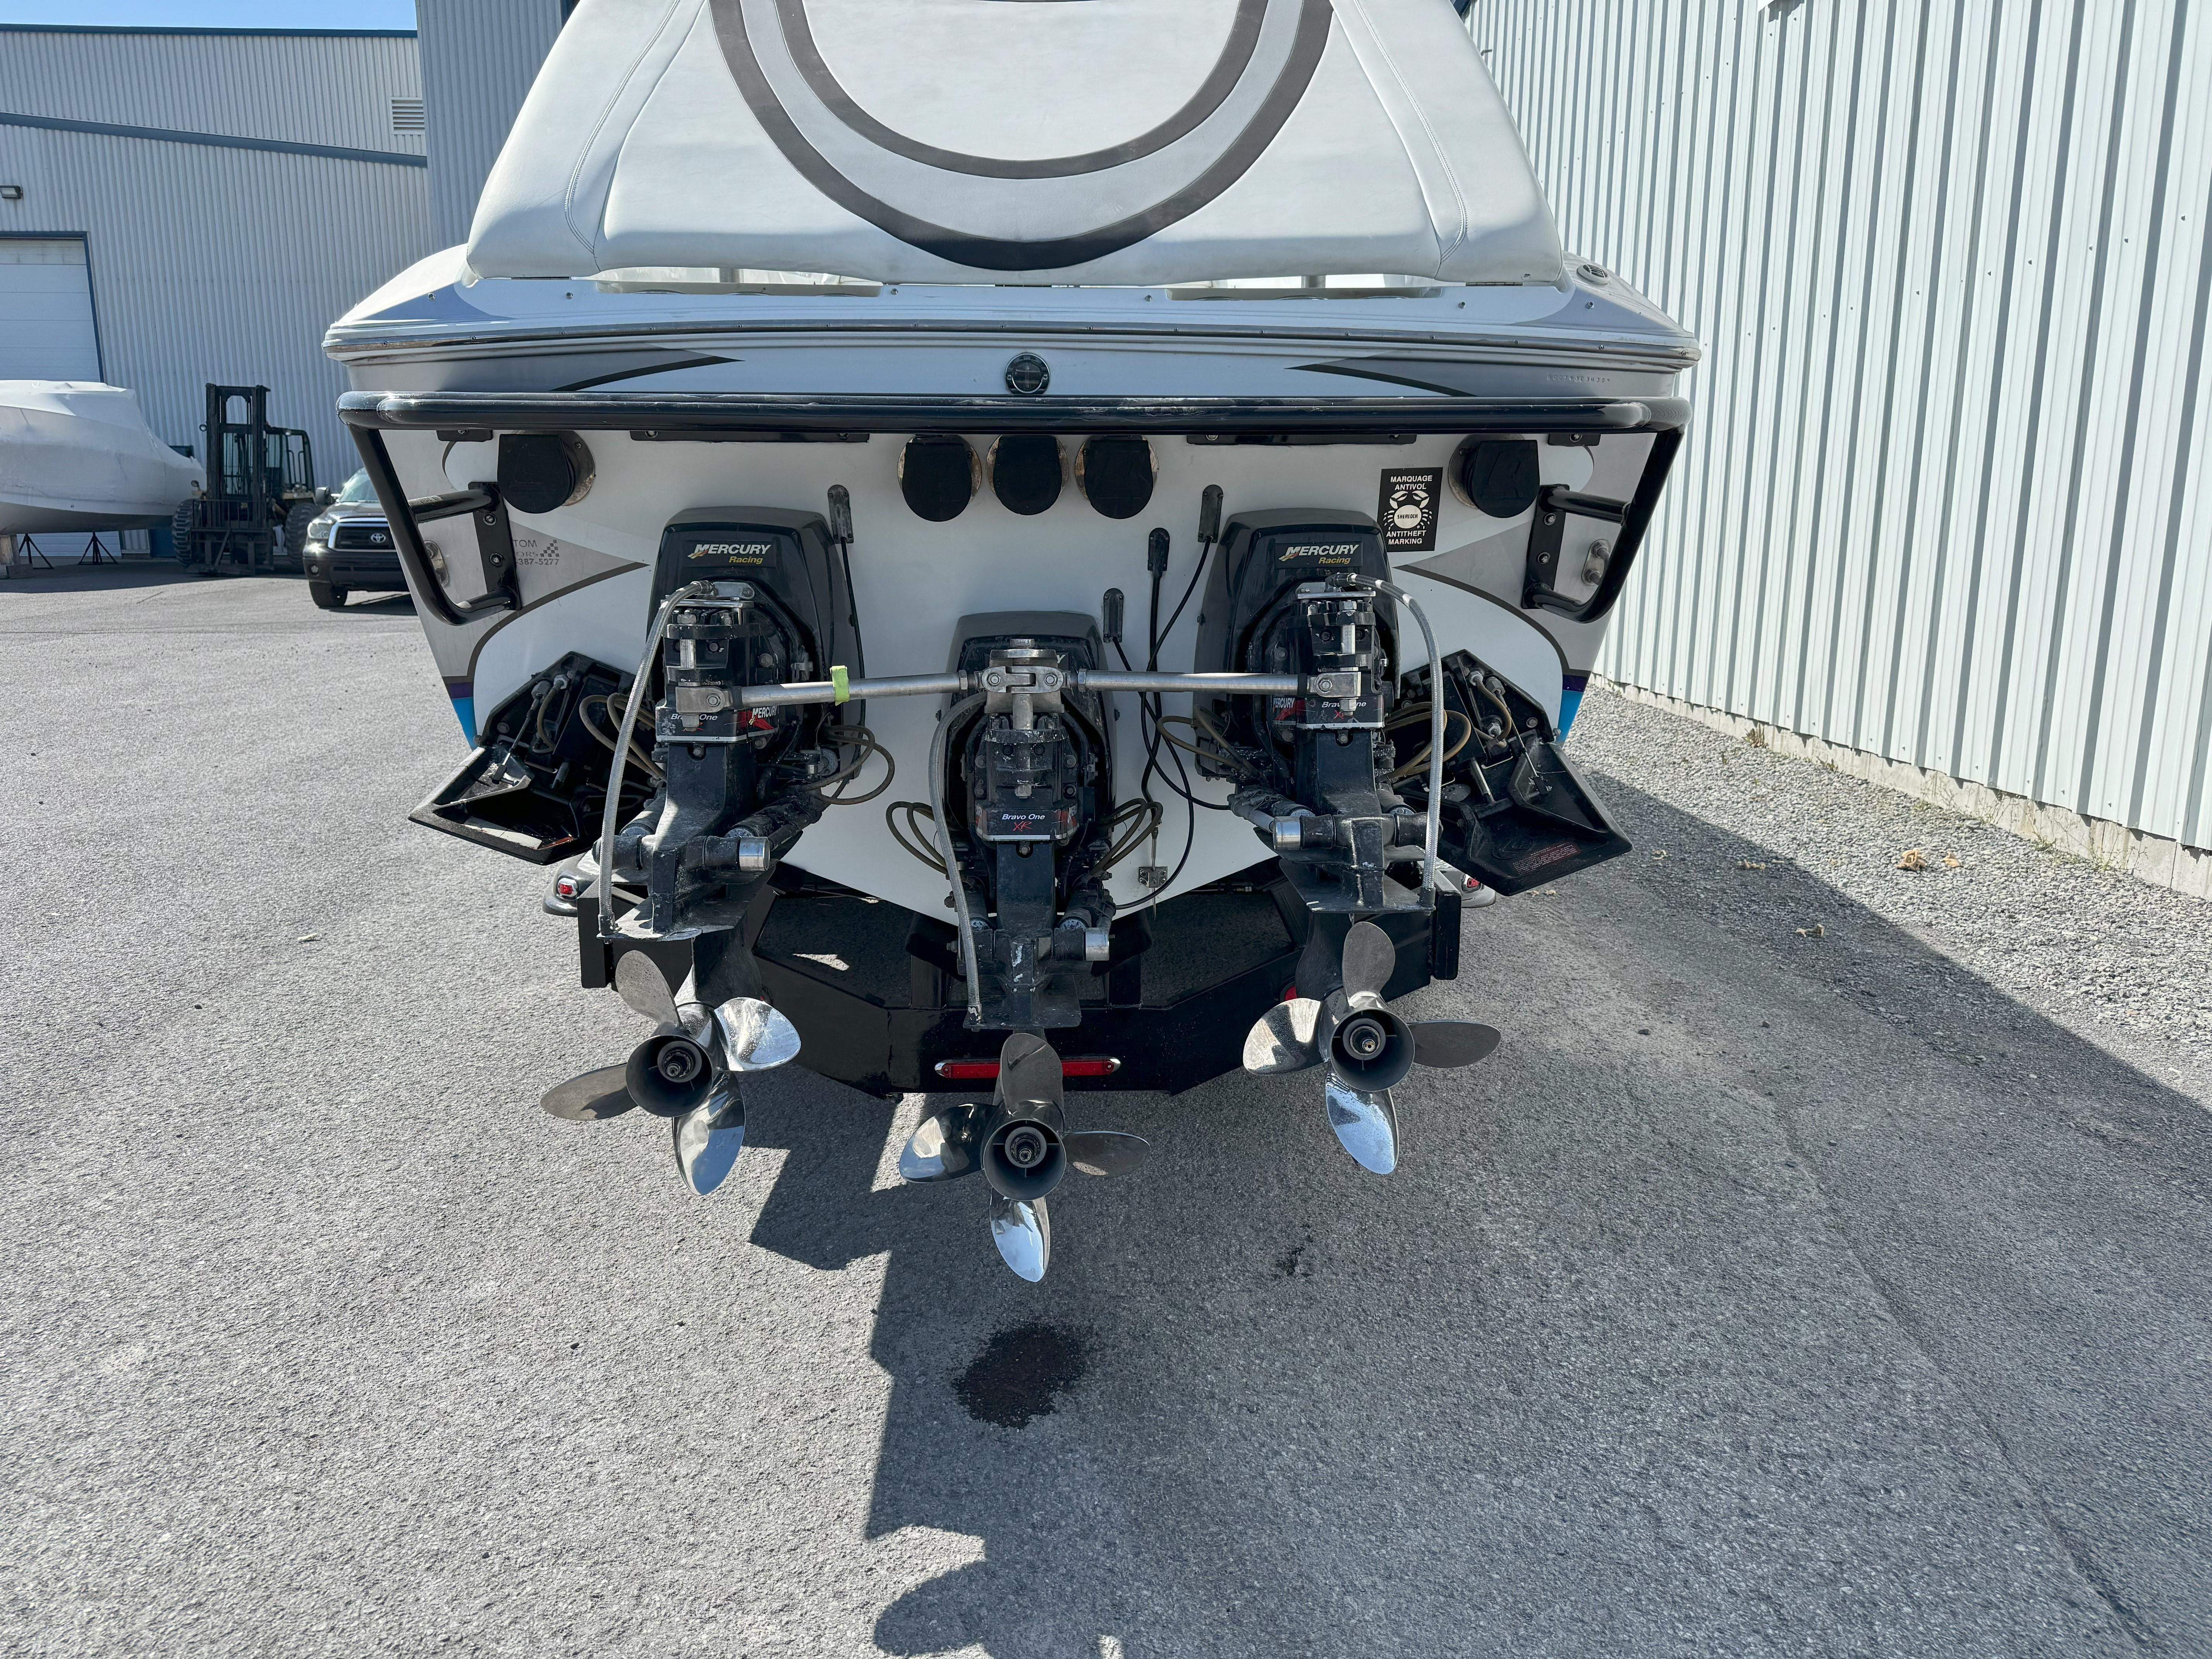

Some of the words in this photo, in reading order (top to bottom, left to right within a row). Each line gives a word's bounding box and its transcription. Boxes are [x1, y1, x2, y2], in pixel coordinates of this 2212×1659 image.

[693, 544, 771, 555] MERCURY
[1284, 544, 1359, 556] MERCURY
[728, 556, 763, 564] Racing
[1318, 556, 1351, 565] Racing
[751, 705, 777, 720] MERCURY
